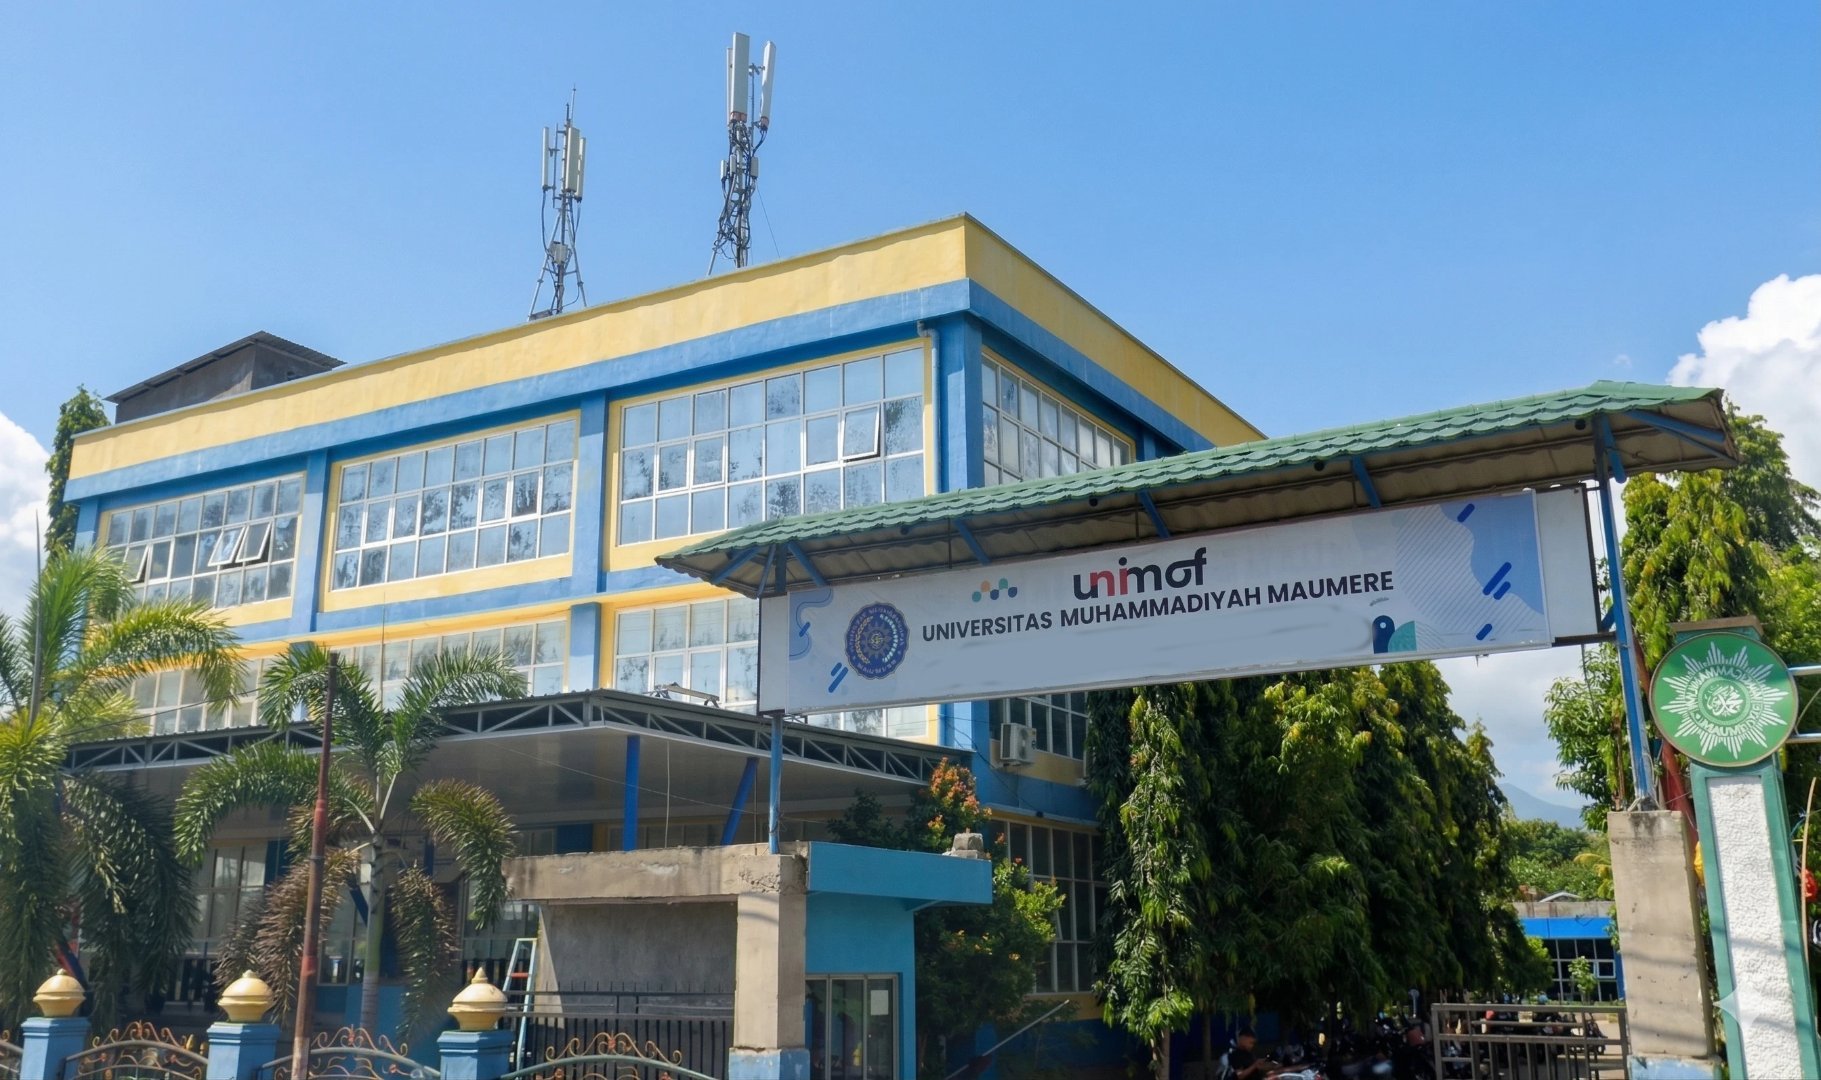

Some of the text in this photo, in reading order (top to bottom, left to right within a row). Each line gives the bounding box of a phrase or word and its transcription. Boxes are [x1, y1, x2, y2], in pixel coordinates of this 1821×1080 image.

[1073, 547, 1207, 600] unimof
[922, 611, 1053, 642] UNIVERSITAS
[1060, 586, 1261, 627] MUHAMMADIYAH
[1267, 570, 1394, 604] MAUMERE
